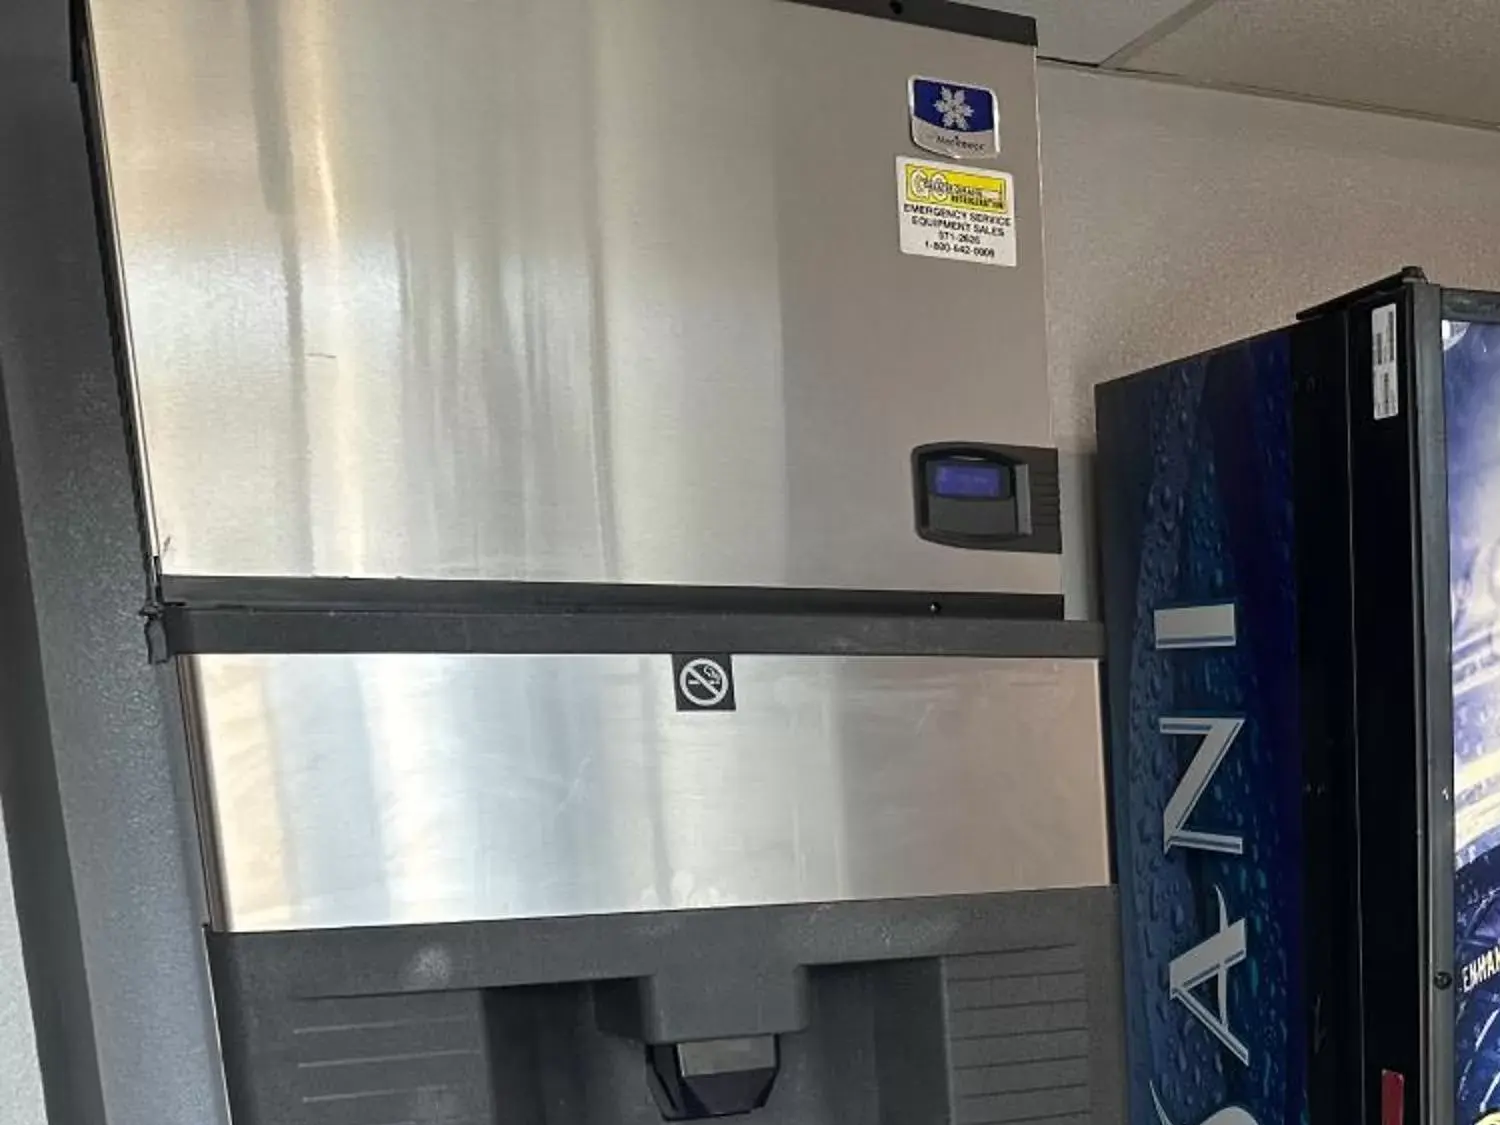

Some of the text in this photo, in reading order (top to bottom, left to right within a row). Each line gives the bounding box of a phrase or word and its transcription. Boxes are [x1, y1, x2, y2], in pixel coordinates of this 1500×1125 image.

[903, 203, 1012, 227] EMERGENCY SERVICE
[911, 216, 1005, 237] EQUIPMENT SALES
